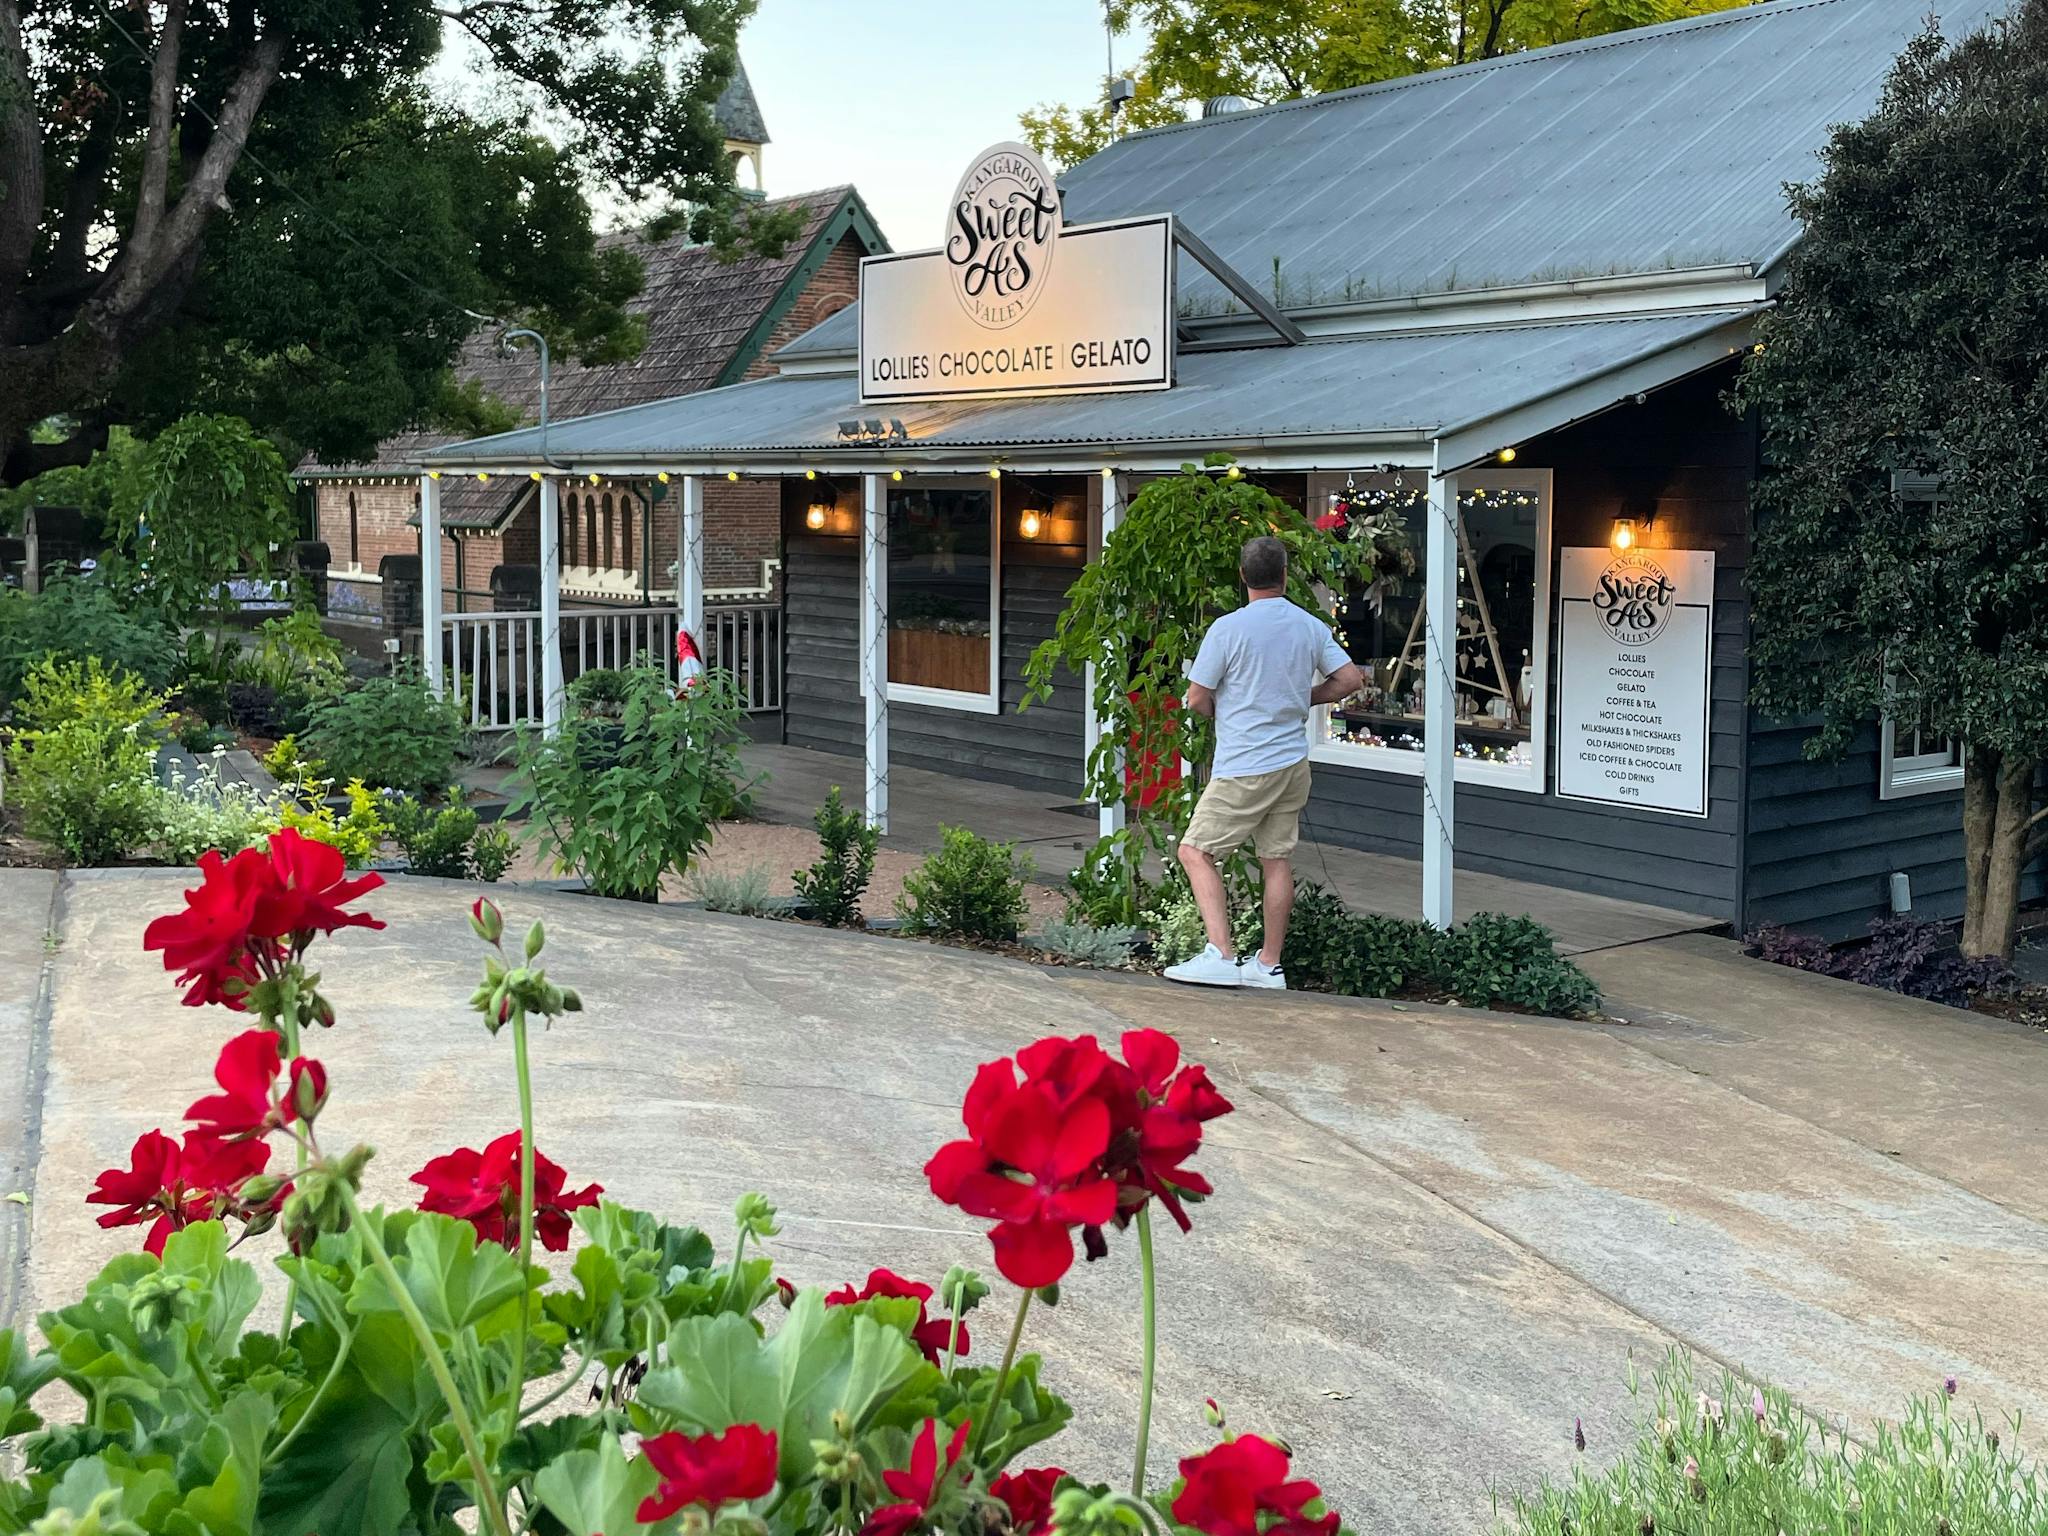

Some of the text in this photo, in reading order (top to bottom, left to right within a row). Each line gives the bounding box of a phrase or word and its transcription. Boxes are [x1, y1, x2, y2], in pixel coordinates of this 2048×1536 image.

[965, 157, 1040, 200] KANGAROO
[947, 187, 1057, 265] Sweet
[974, 296, 1025, 322] VALLEY
[872, 337, 1151, 382] LOLLIES CHOCOLATE GELATO
[1608, 558, 1662, 579] KANGAROO
[1593, 574, 1676, 608] Sweet
[1614, 628, 1651, 642] VALLEY
[1618, 653, 1646, 663] LOLLIES
[1609, 667, 1655, 679] CHOCOLATE
[1617, 683, 1646, 693] GELATO
[1606, 697, 1656, 709] COFFEE & TEA
[1599, 711, 1662, 725] HOT CHOCOLATE
[1581, 723, 1681, 742] MILKSHAKES & THICKSHAKES
[1586, 738, 1675, 756] OLD FASHIONED SPIDERS
[1579, 752, 1682, 772] ICED COFFEE & CHOCOLATE
[1604, 770, 1655, 784] COLD DRINKS
[1619, 786, 1640, 797] GIFTS
